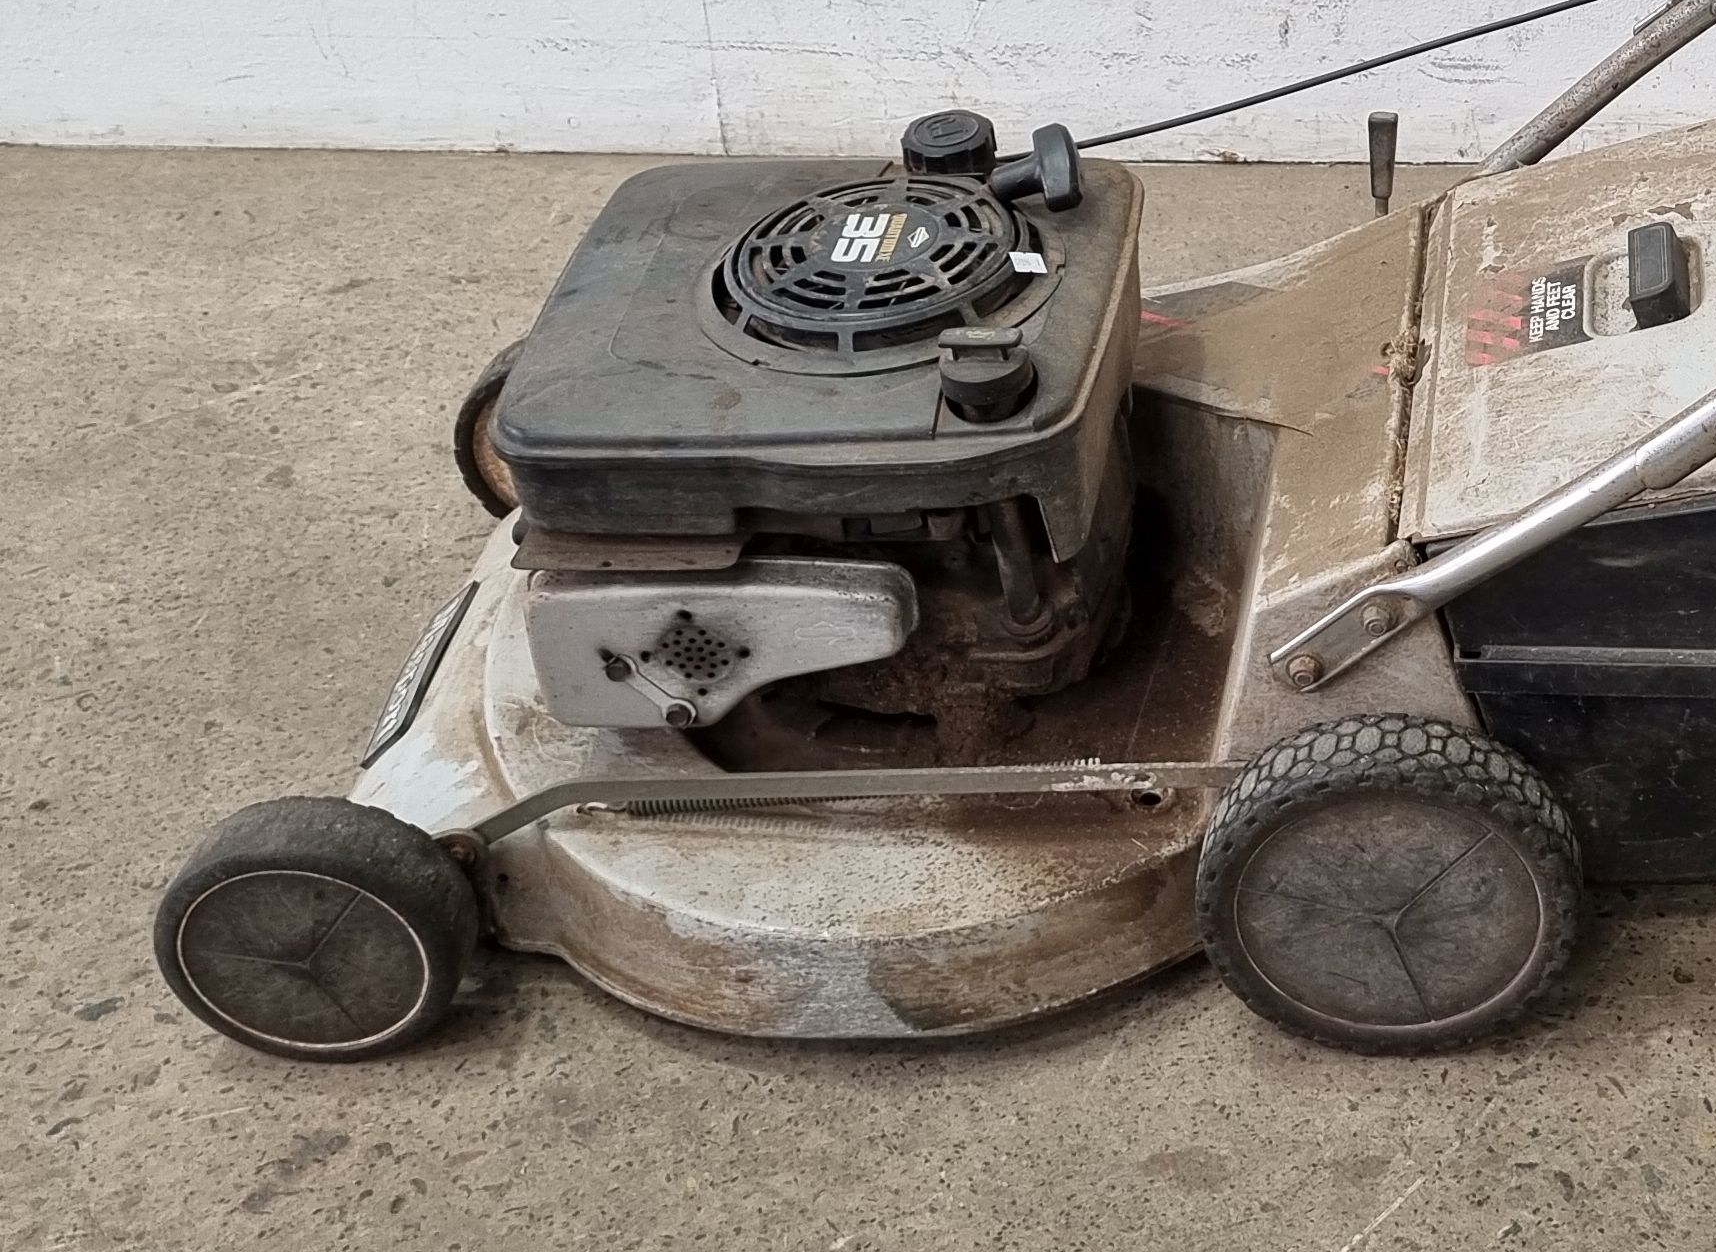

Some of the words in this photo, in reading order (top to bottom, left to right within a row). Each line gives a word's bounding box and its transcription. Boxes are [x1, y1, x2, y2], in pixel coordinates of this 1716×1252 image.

[831, 213, 890, 263] 35
[1531, 276, 1547, 314] HANDS
[1546, 281, 1561, 308] FEET
[1561, 284, 1576, 321] CLEAR
[1529, 315, 1544, 343] KEEP
[1545, 307, 1560, 331] AND
